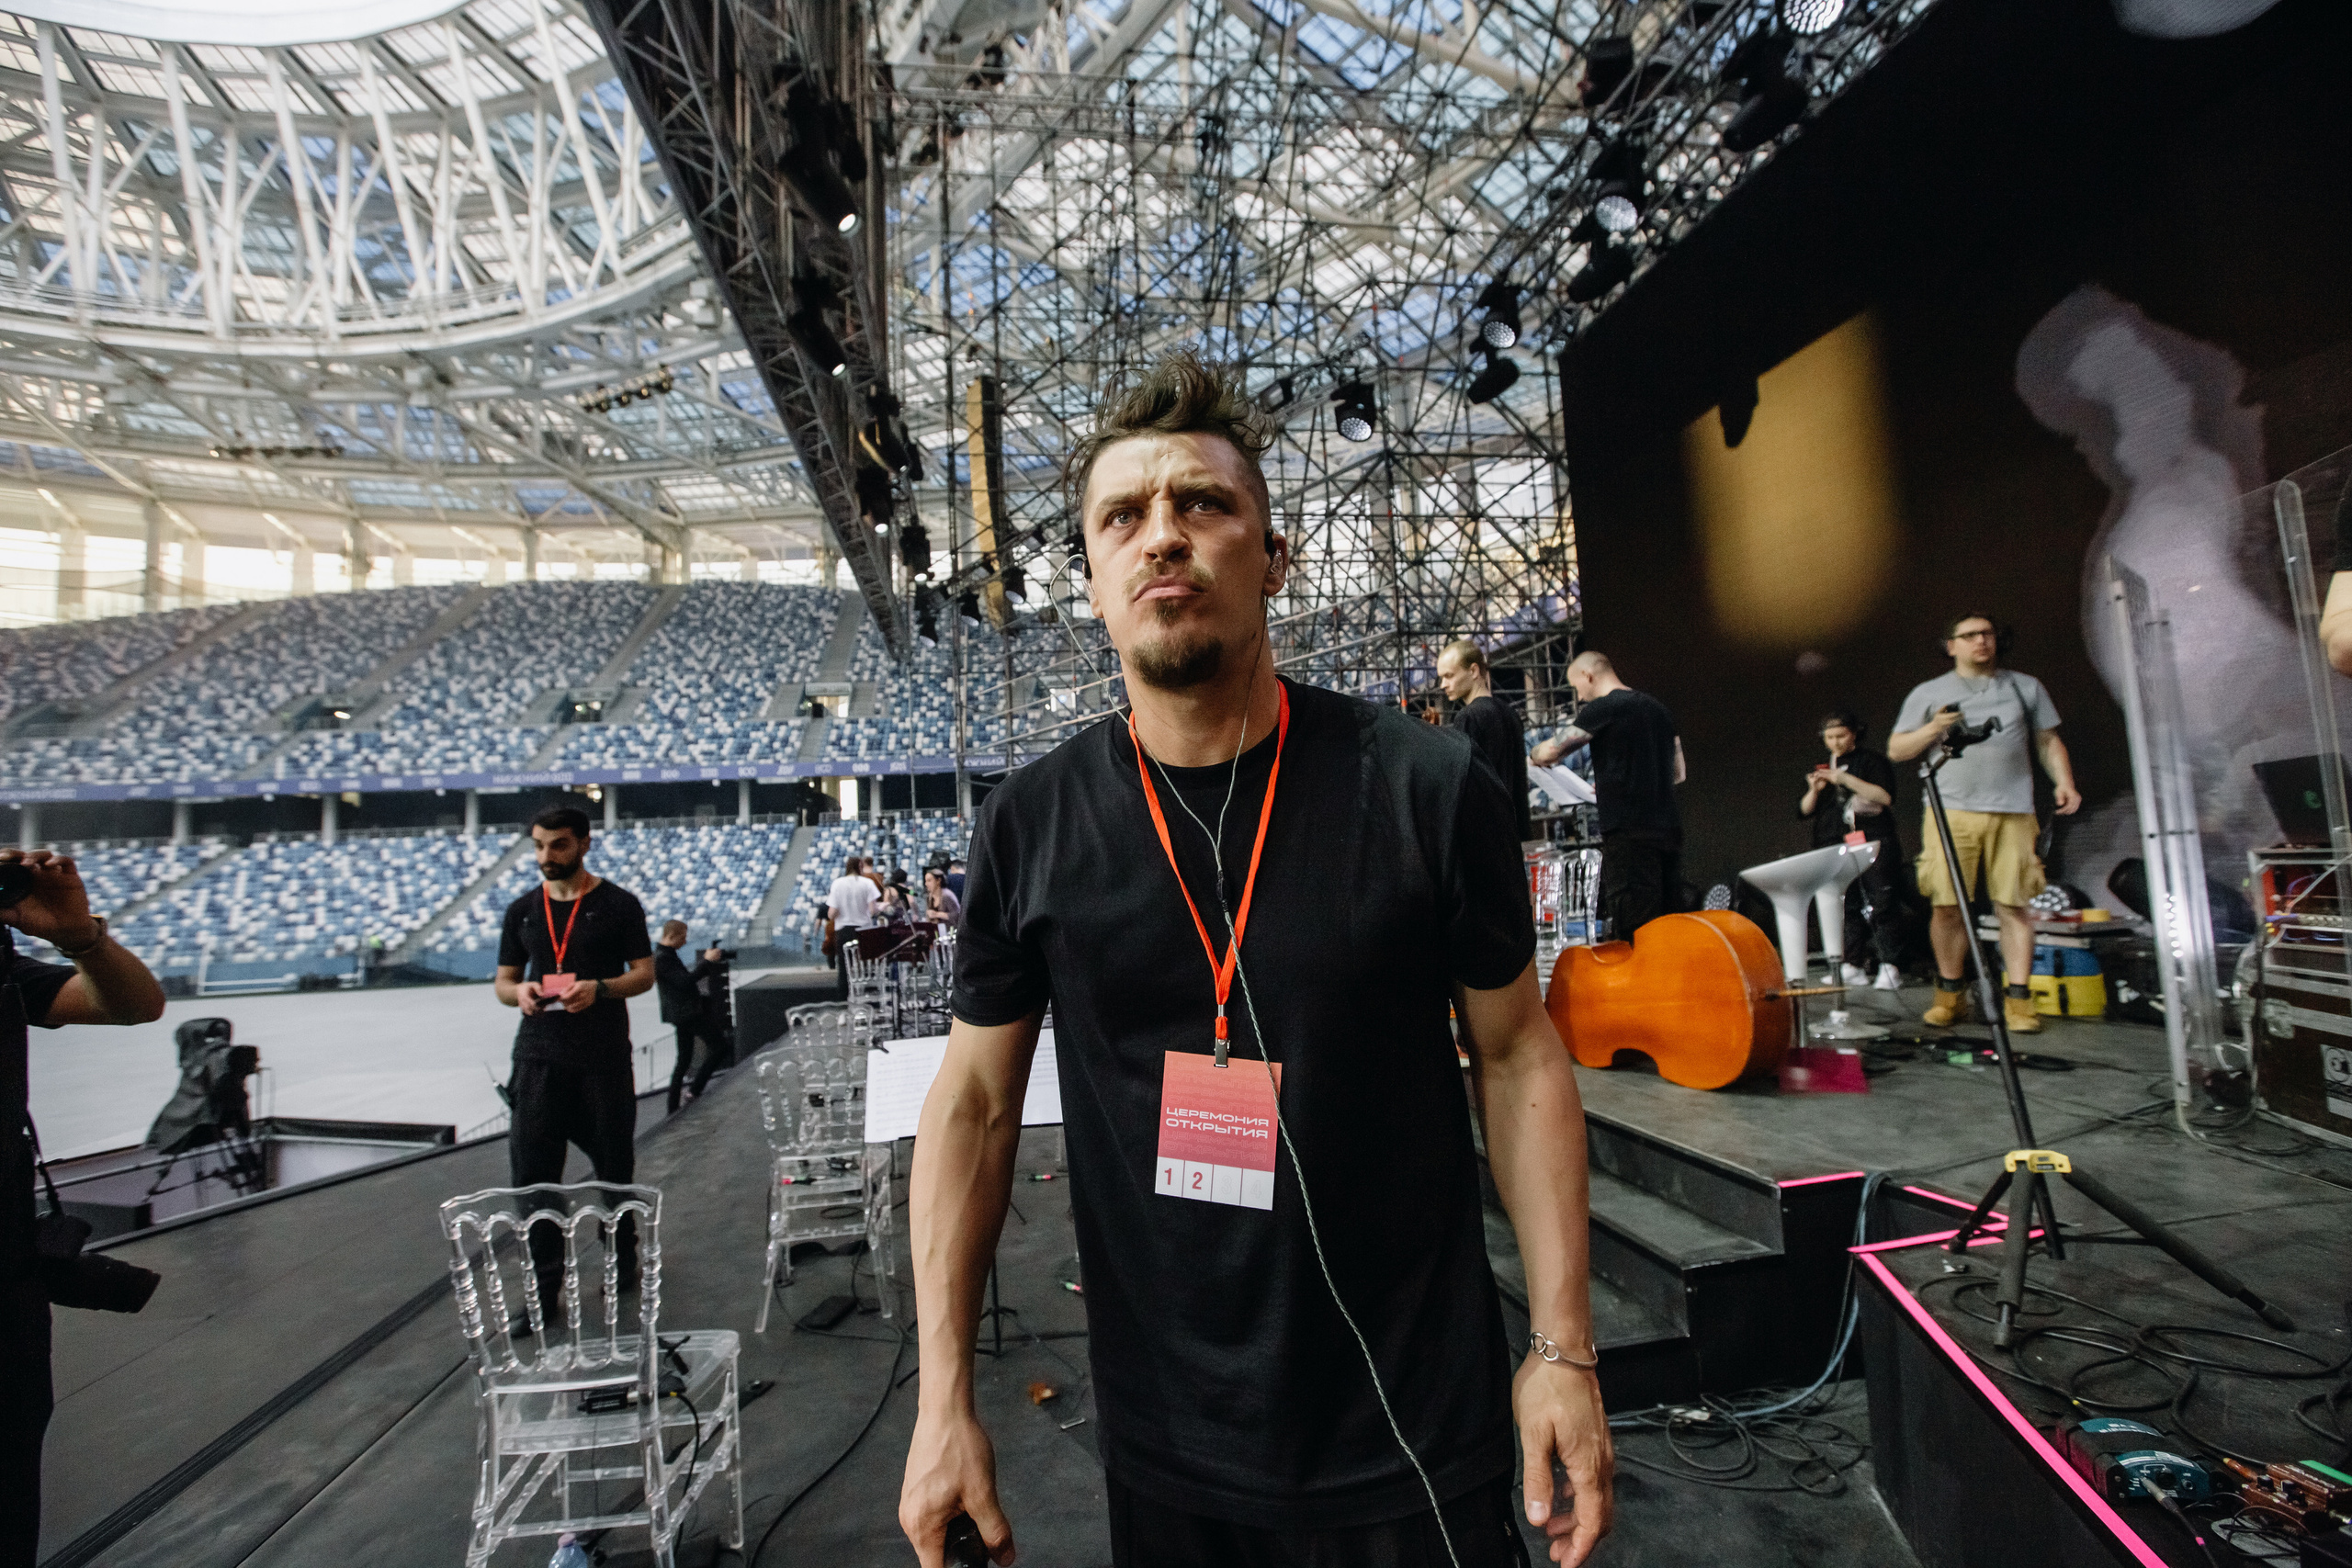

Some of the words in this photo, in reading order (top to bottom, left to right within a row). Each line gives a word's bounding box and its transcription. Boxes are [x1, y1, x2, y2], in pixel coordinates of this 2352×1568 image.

[1166, 1106, 1270, 1127] ЦЕРЕМОНИЯ
[1165, 1118, 1269, 1139] ОТКРЫТИЯ
[1164, 1168, 1172, 1186] 1
[1192, 1171, 1203, 1190] 2
